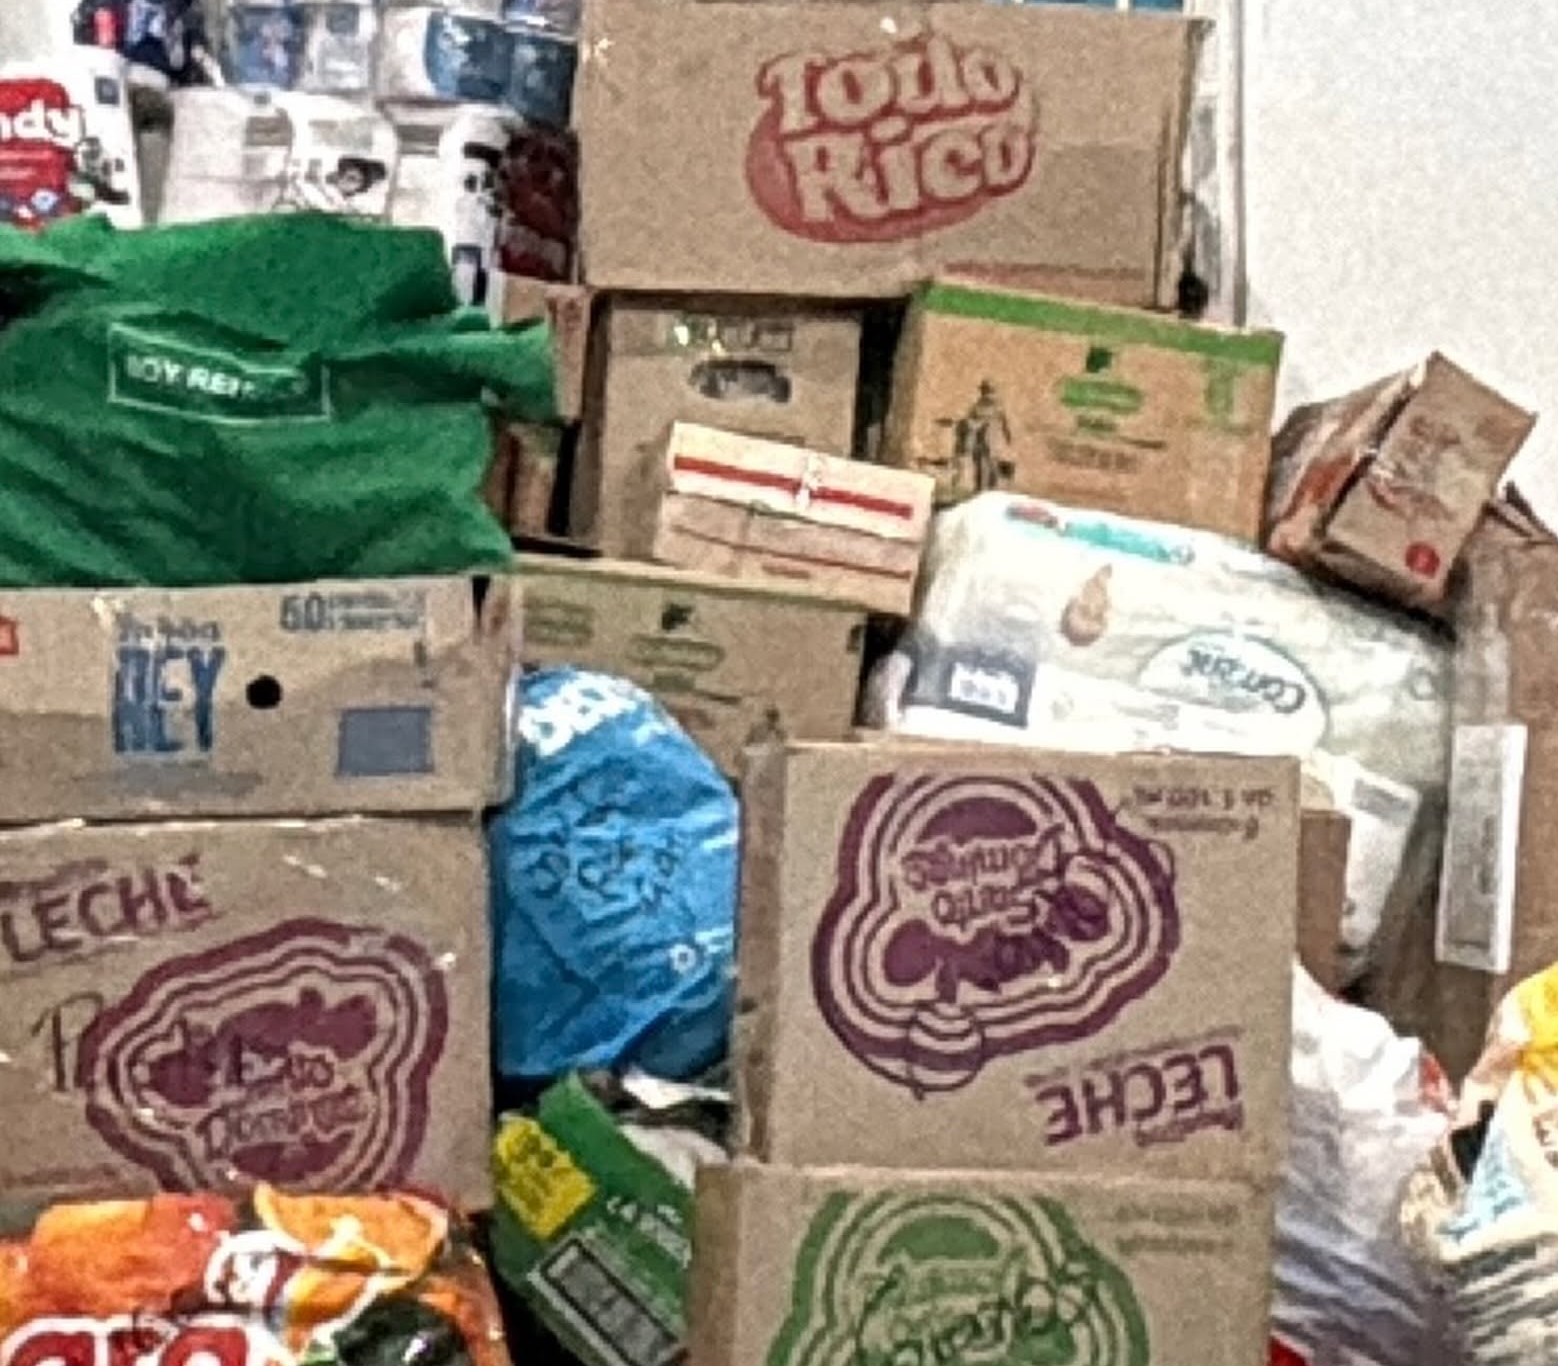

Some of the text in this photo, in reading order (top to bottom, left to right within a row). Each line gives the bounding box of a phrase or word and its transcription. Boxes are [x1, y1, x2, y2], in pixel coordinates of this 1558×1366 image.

[757, 33, 1024, 135] Todo
[783, 119, 1035, 223] Rico
[3, 857, 210, 963] LECHE
[1036, 1045, 1242, 1146] LECHE
